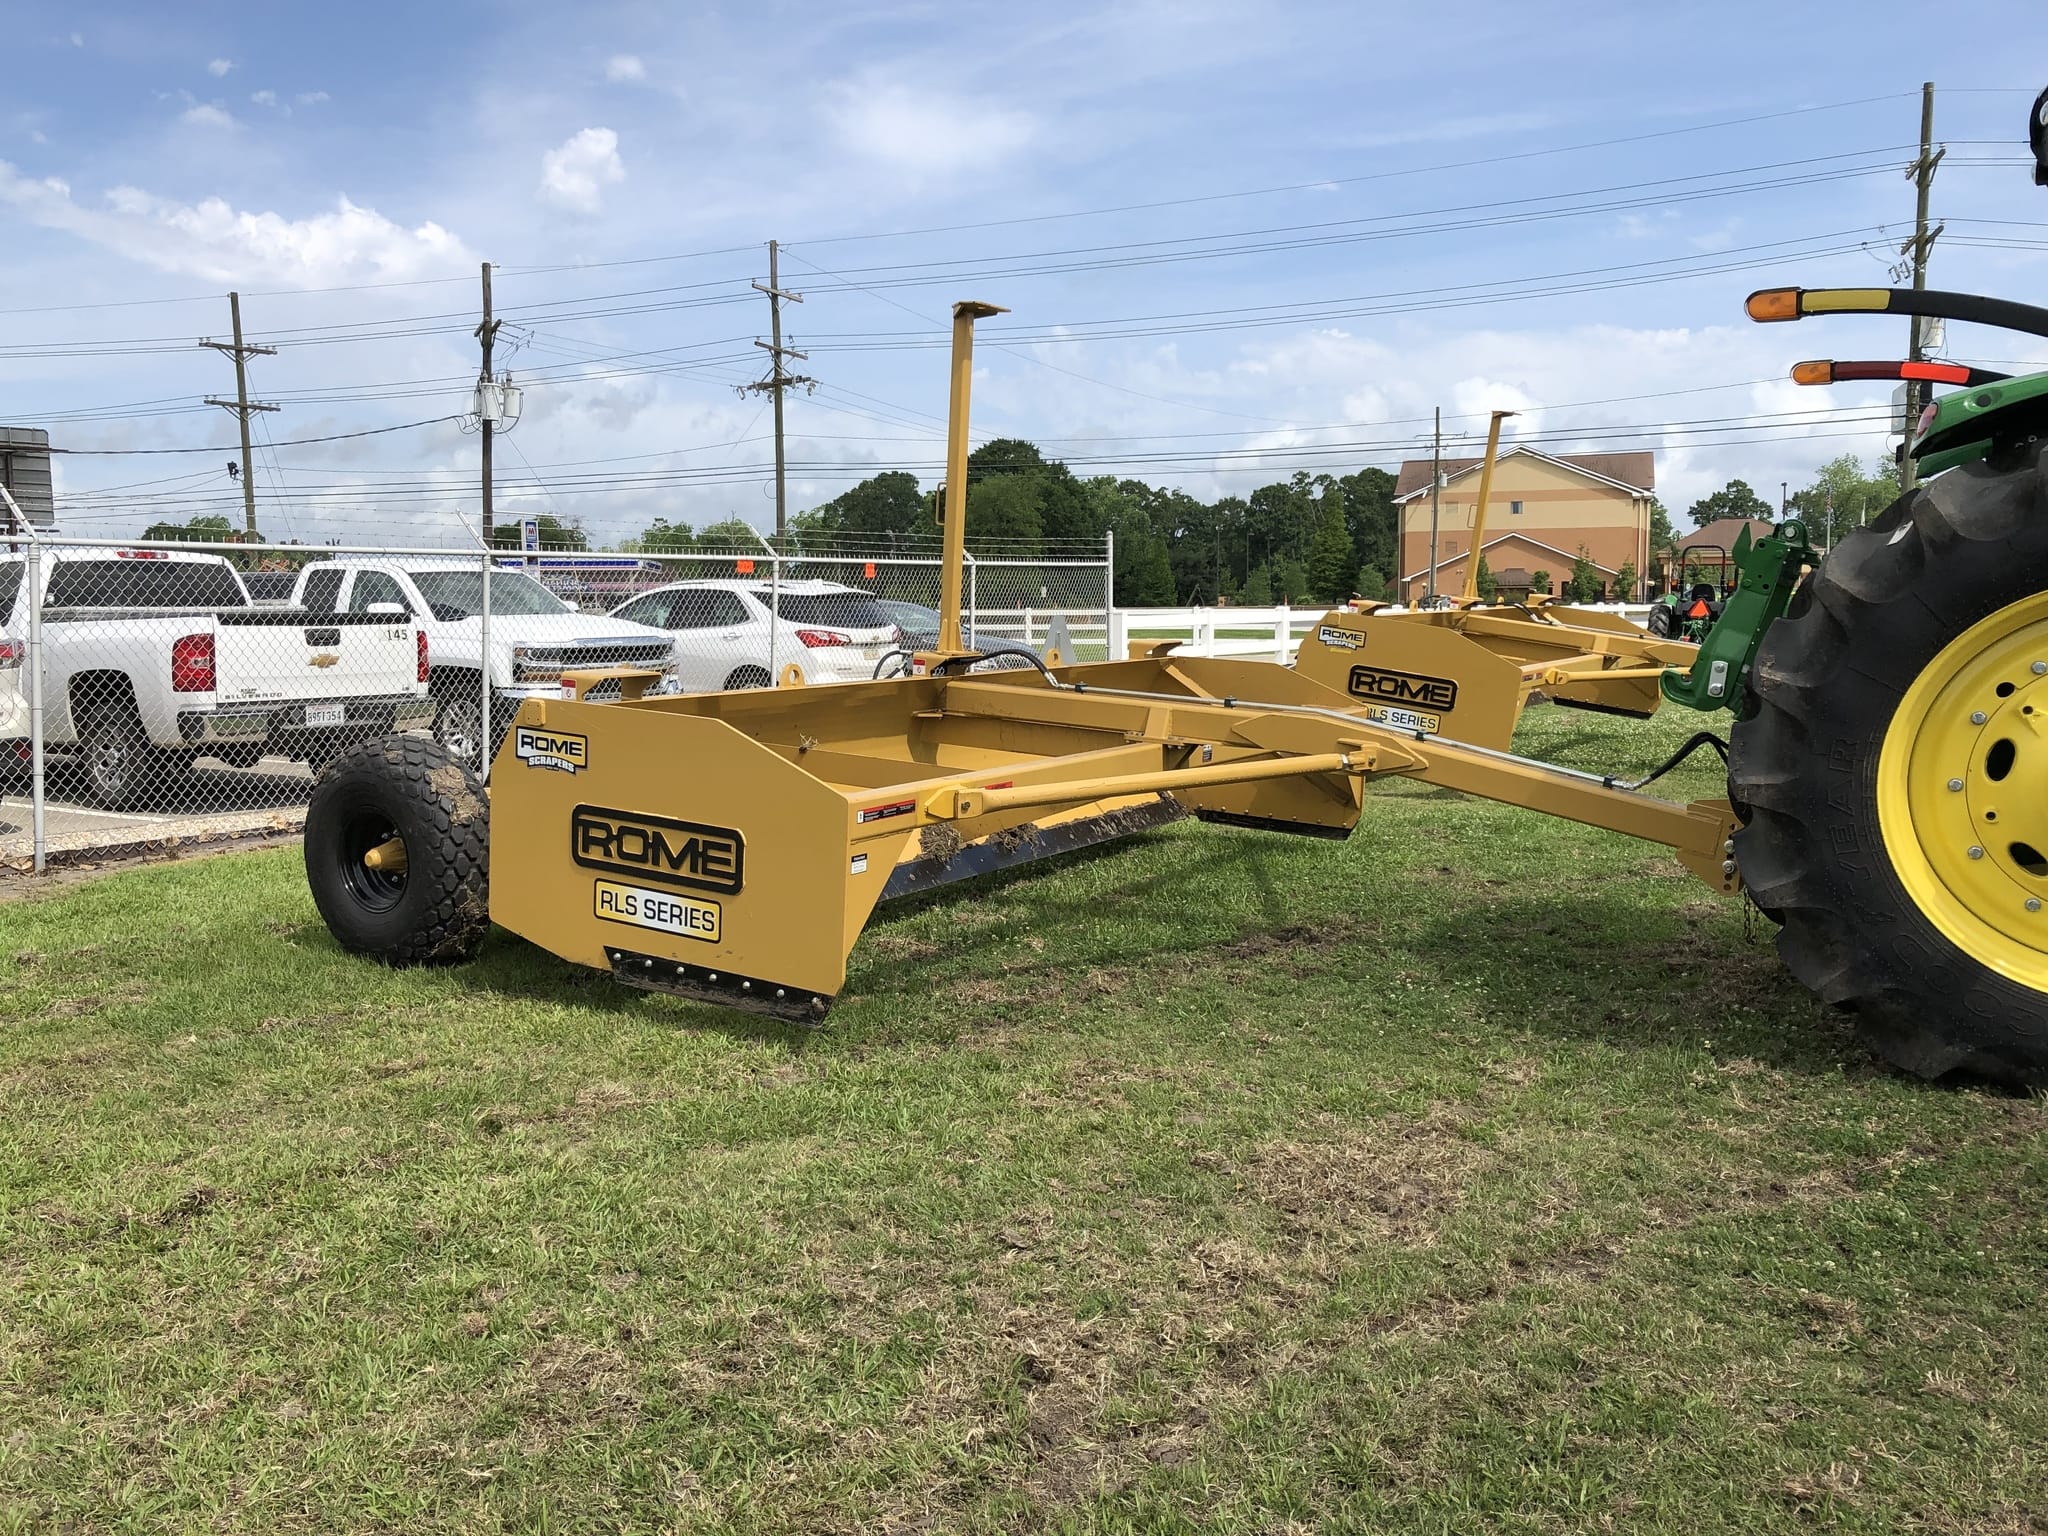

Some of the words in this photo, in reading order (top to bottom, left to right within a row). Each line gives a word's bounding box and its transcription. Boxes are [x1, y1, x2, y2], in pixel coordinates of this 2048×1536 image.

[387, 629, 408, 641] 145
[1322, 629, 1363, 642] ROME
[1354, 672, 1452, 705] ROME
[1391, 713, 1436, 729] SERIES
[521, 734, 583, 757] ROME
[528, 755, 575, 773] SCRAPERS
[580, 818, 736, 881] ROME
[600, 890, 638, 916] RLS
[643, 899, 716, 932] SERIES
